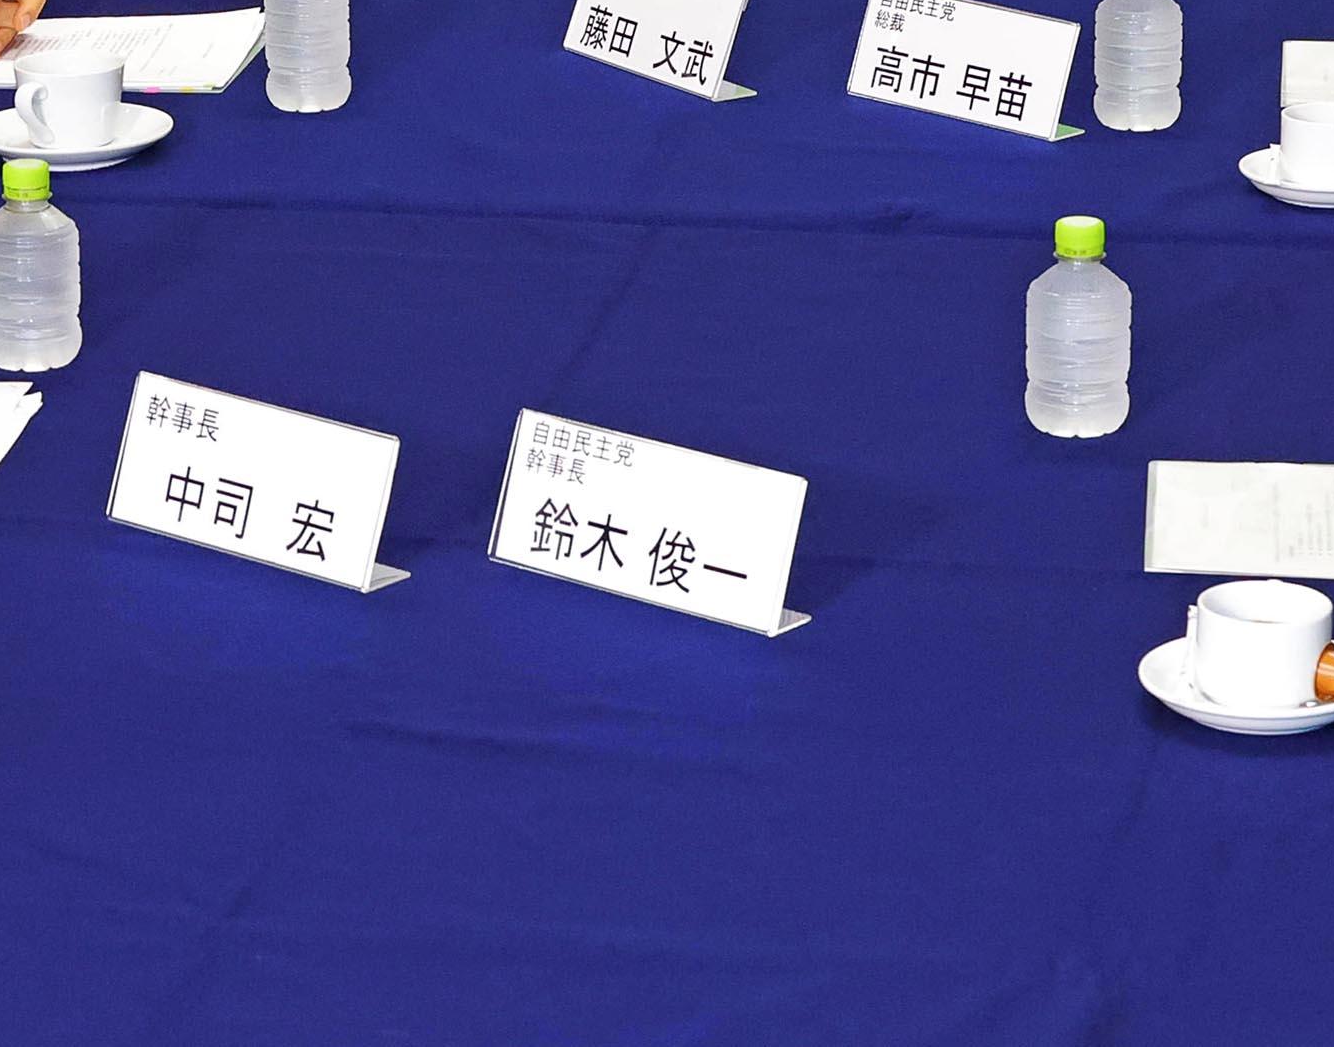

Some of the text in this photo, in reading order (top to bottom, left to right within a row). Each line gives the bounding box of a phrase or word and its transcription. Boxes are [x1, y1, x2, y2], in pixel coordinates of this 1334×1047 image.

[579, 4, 715, 86] 藤田 文武
[874, 8, 906, 33] 総裁
[870, 45, 1033, 122] 高市 早苗
[146, 393, 220, 442] 幹事長
[532, 420, 635, 468] 自由民主党
[526, 448, 587, 485] 幹事長
[165, 466, 335, 562] 中司 宏
[530, 497, 748, 594] 鈴木 俊一
